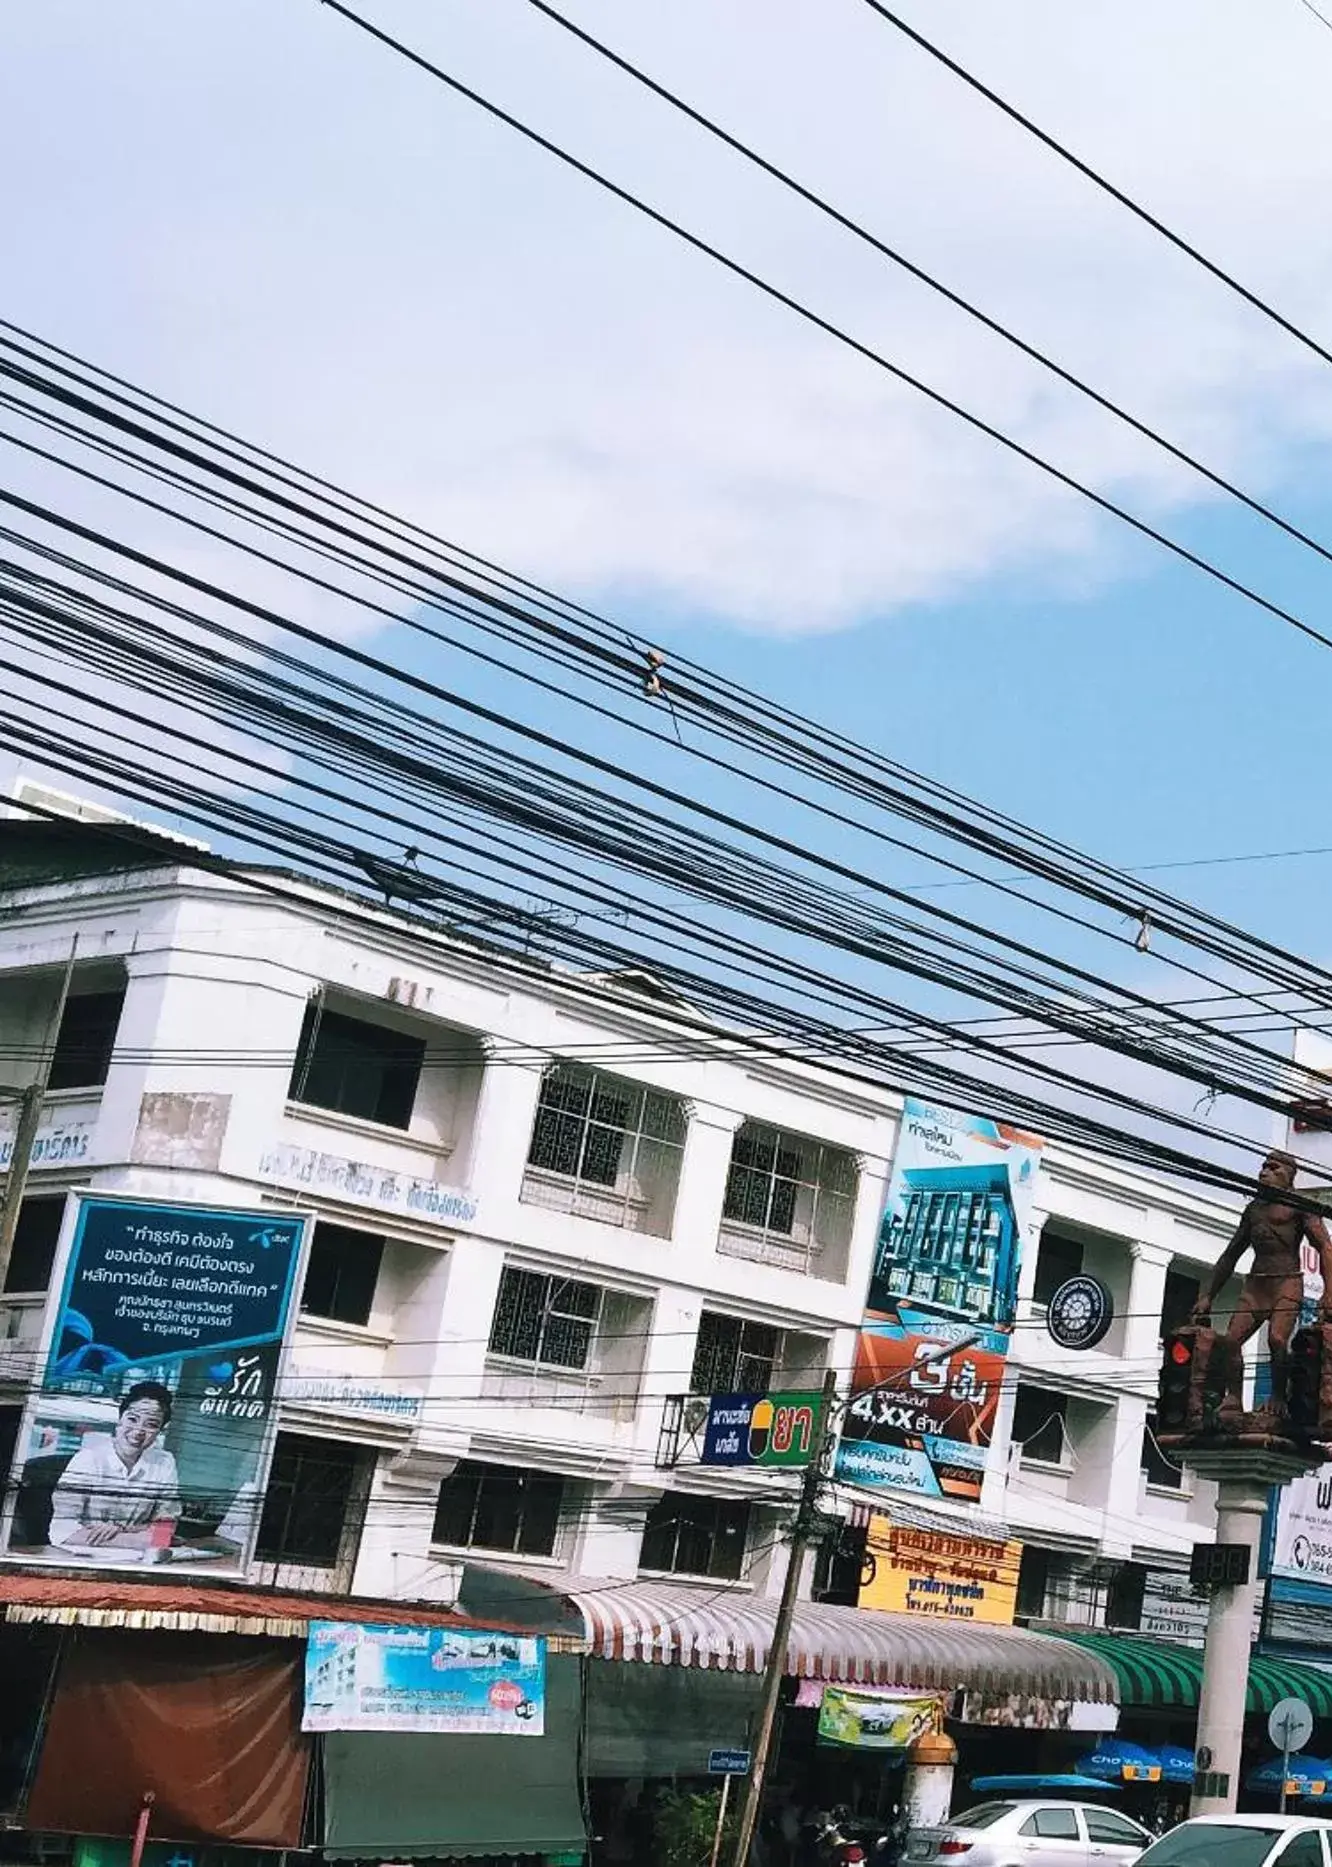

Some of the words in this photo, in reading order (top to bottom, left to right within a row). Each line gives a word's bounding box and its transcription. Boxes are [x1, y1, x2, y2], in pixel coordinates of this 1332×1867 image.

[228, 1355, 262, 1395] รัก
[200, 1387, 264, 1418] ดีแทค
[772, 1406, 813, 1452] ยา
[916, 1413, 945, 1435] ล้าน
